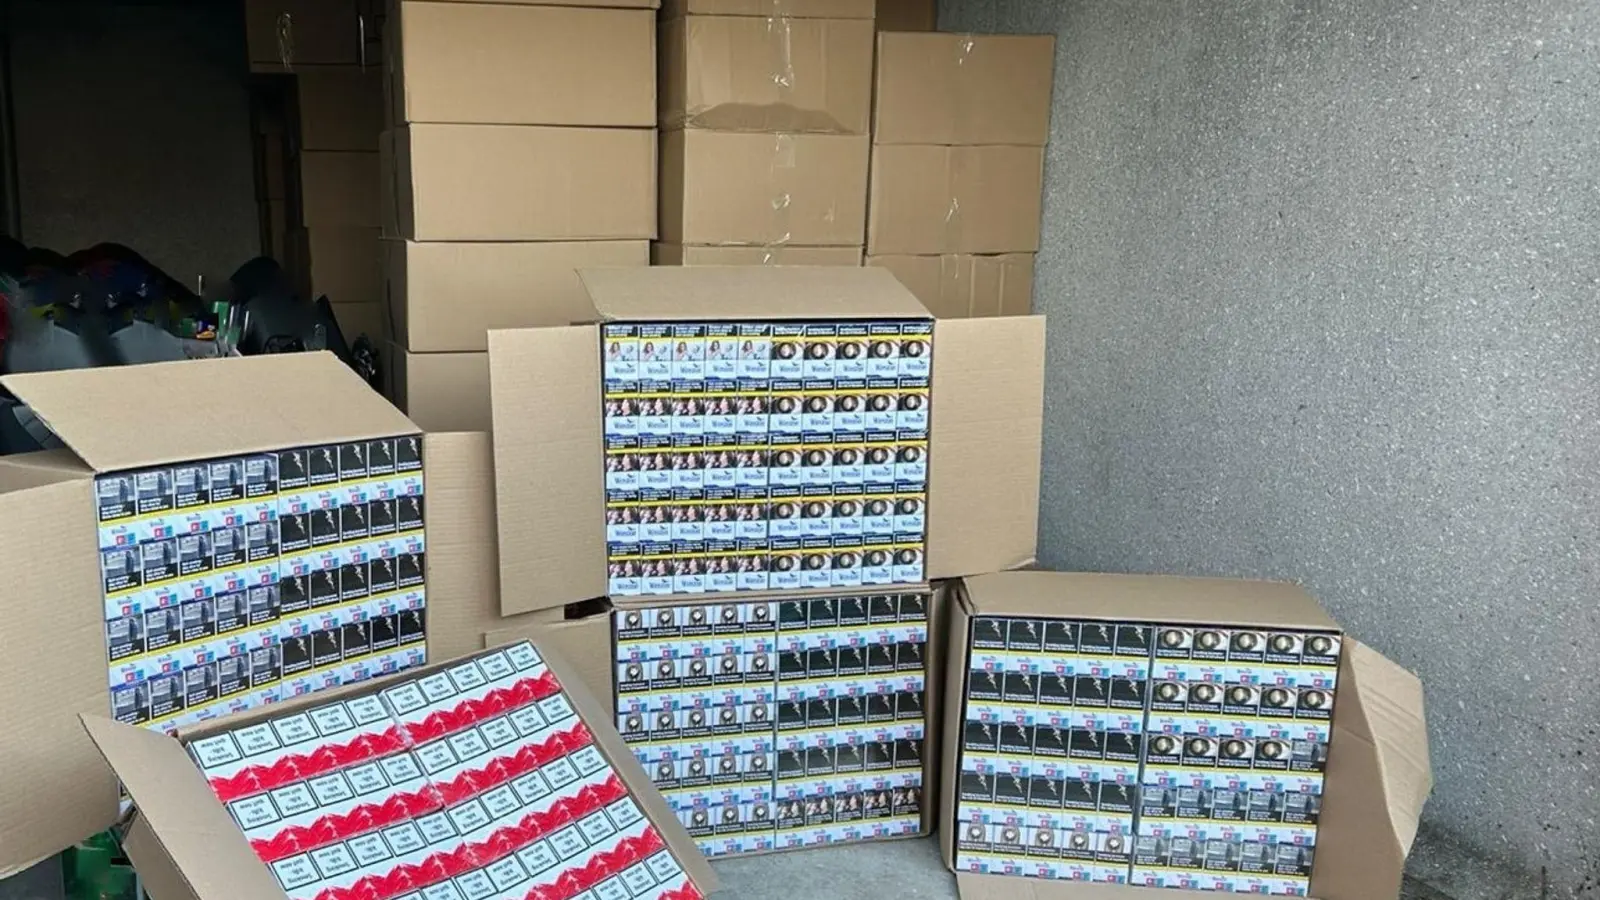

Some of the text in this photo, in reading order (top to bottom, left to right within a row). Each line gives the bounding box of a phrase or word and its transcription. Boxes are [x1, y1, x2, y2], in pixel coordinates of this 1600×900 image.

[286, 730, 311, 740] Smoking
[247, 740, 273, 750] Smoking
[206, 752, 233, 762] Smoking
[322, 790, 347, 800] Smoking
[285, 801, 310, 811] Smoking
[246, 813, 272, 823] Smoking
[361, 850, 385, 860] Smoking
[325, 862, 350, 872] Smoking
[531, 857, 552, 870] Smoking
[287, 873, 313, 884] Smoking
[499, 873, 521, 886] Smoking
